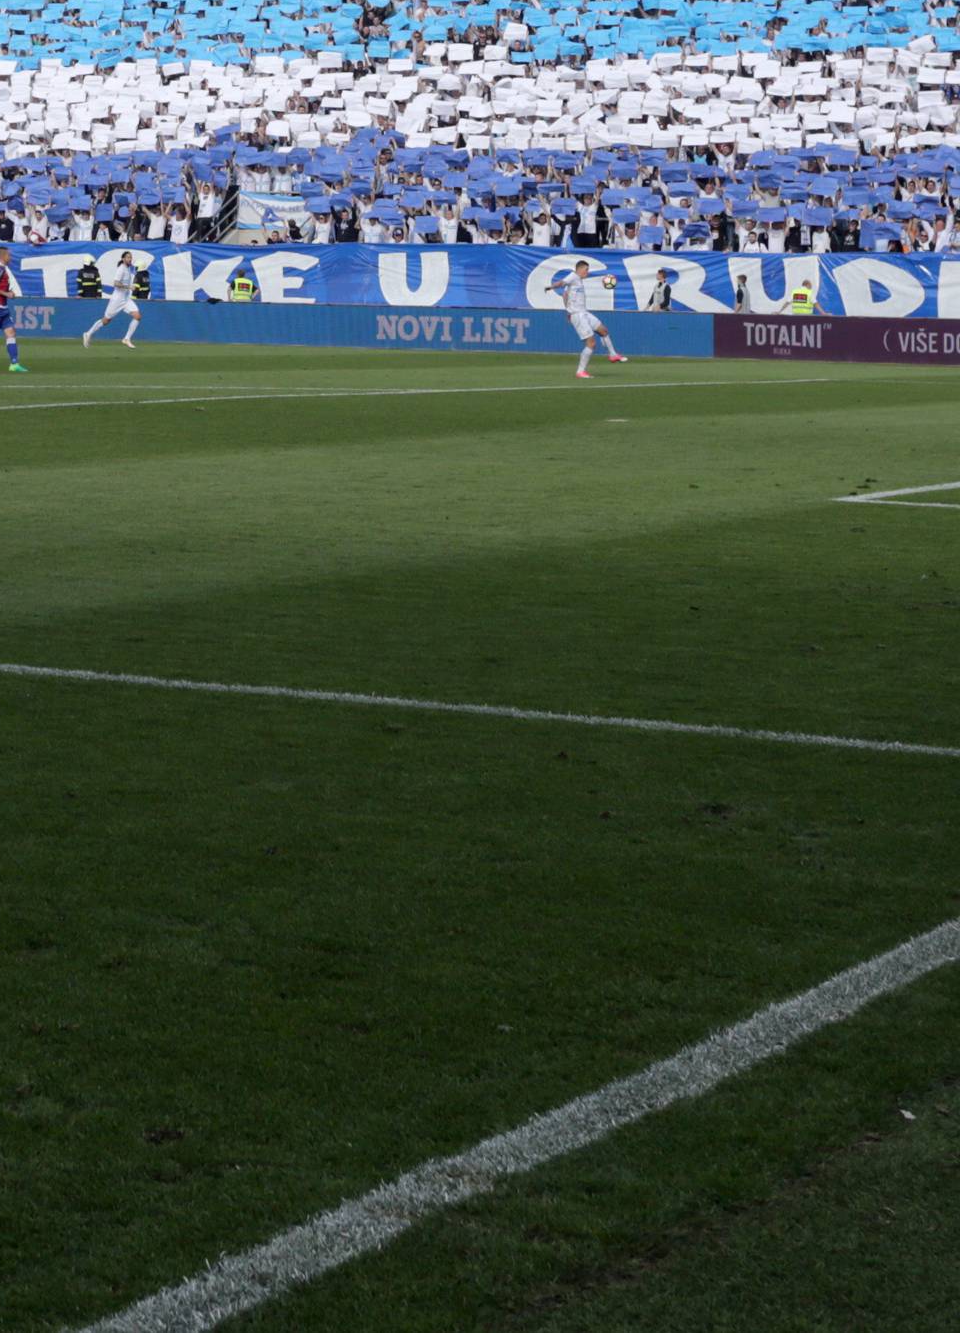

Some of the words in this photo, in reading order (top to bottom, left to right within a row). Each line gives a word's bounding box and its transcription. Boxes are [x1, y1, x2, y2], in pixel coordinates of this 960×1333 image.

[378, 251, 449, 306] U
[14, 306, 55, 330] IST
[376, 315, 452, 341] NOVI
[462, 317, 530, 344] LIST
[743, 322, 822, 349] TOTALNI
[898, 328, 938, 353] VIŠE
